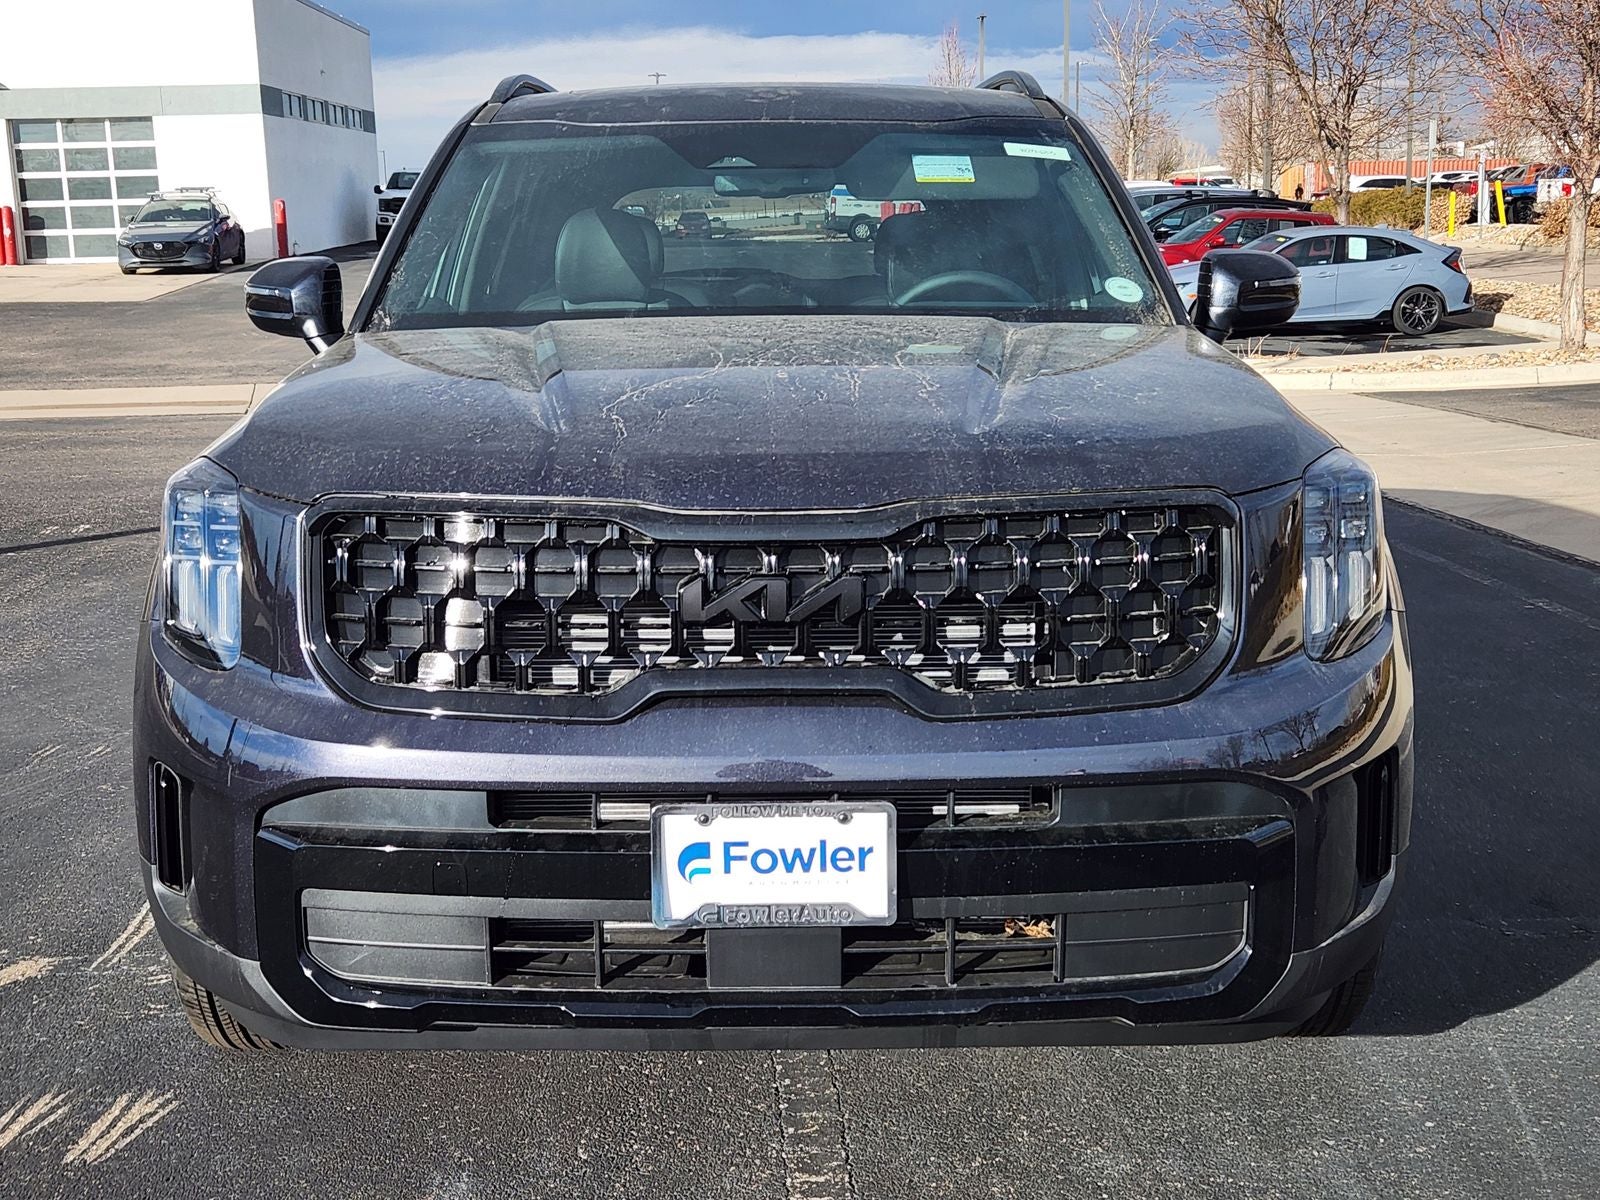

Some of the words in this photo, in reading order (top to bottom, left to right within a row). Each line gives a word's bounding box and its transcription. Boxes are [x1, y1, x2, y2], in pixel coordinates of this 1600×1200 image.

[681, 576, 864, 623] KIA
[712, 805, 774, 818] FOLLOW
[779, 805, 802, 817] ME
[723, 840, 874, 874] Fowler
